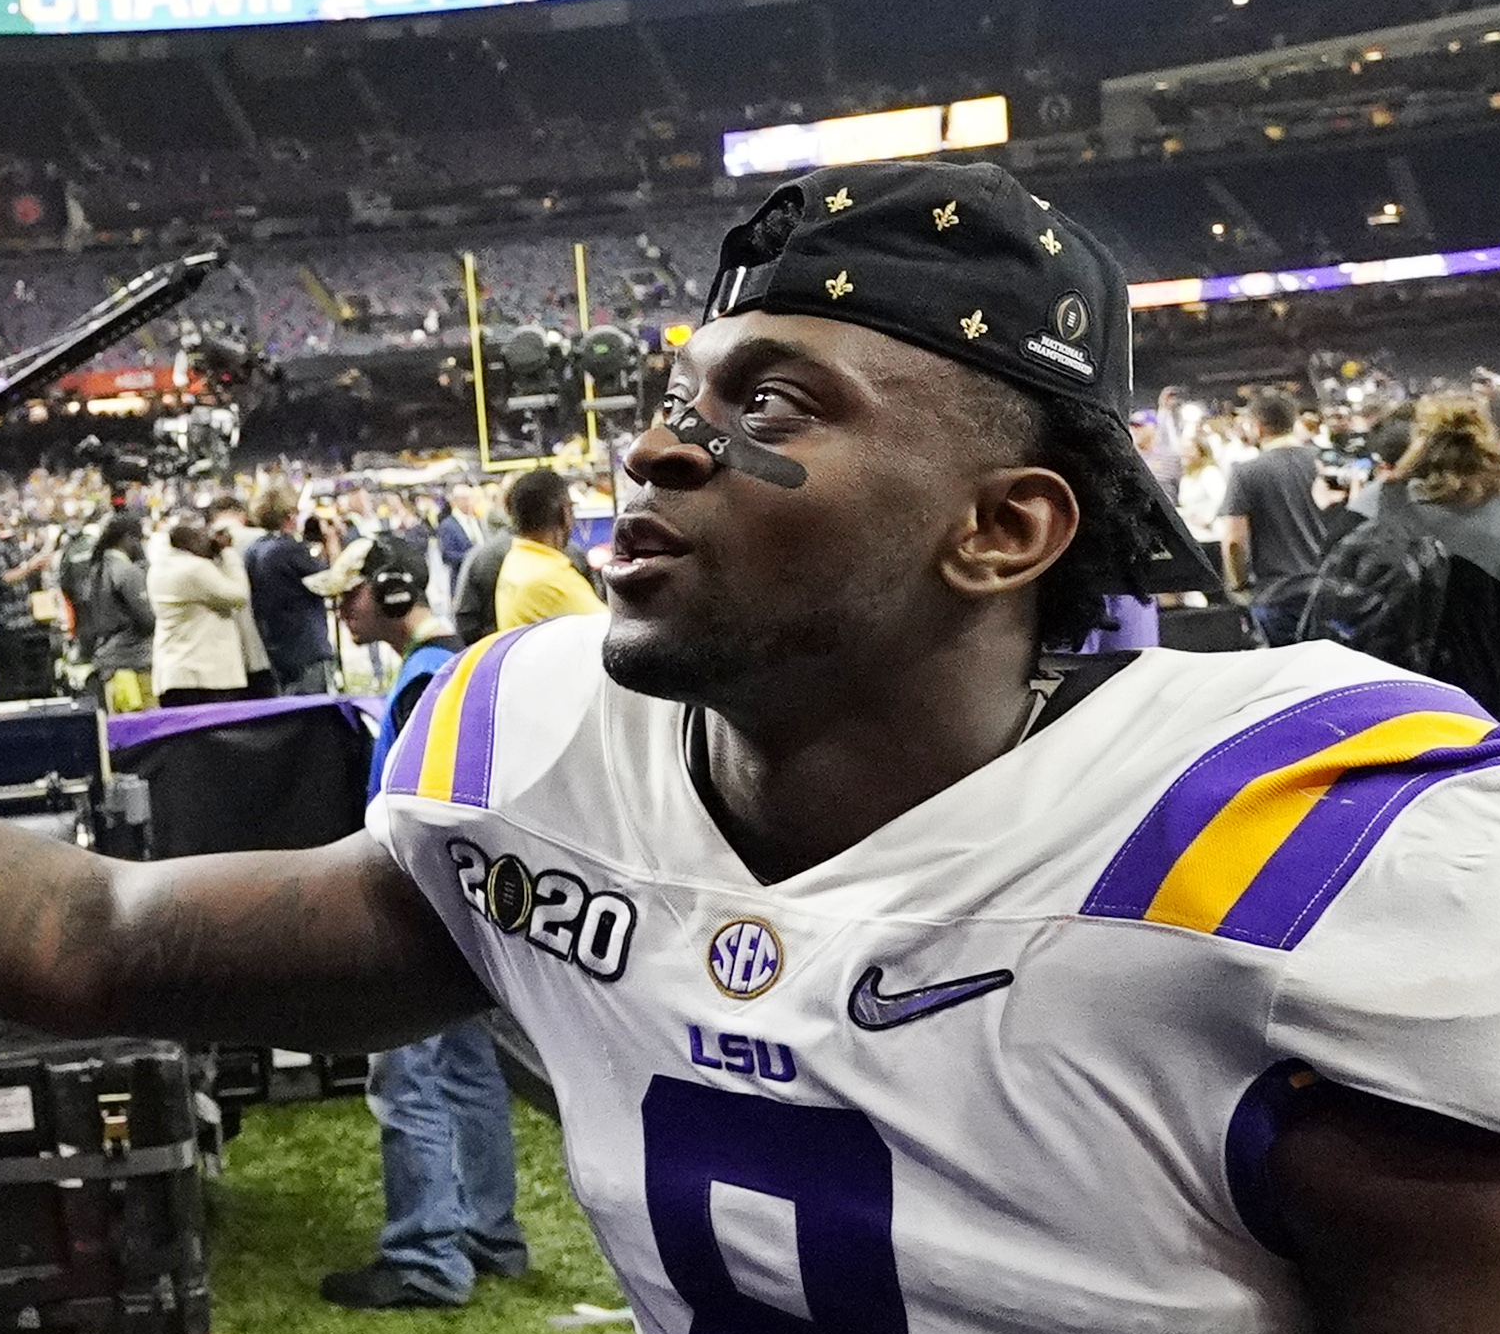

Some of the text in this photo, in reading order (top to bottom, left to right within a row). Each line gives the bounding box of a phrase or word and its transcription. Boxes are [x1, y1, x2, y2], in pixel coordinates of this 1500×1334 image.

[1027, 340, 1093, 376] CHAMPIONSHIP
[1040, 335, 1085, 362] NATIONAL
[708, 435, 732, 456] 8
[709, 921, 780, 995] SEC
[688, 1024, 798, 1083] LSU
